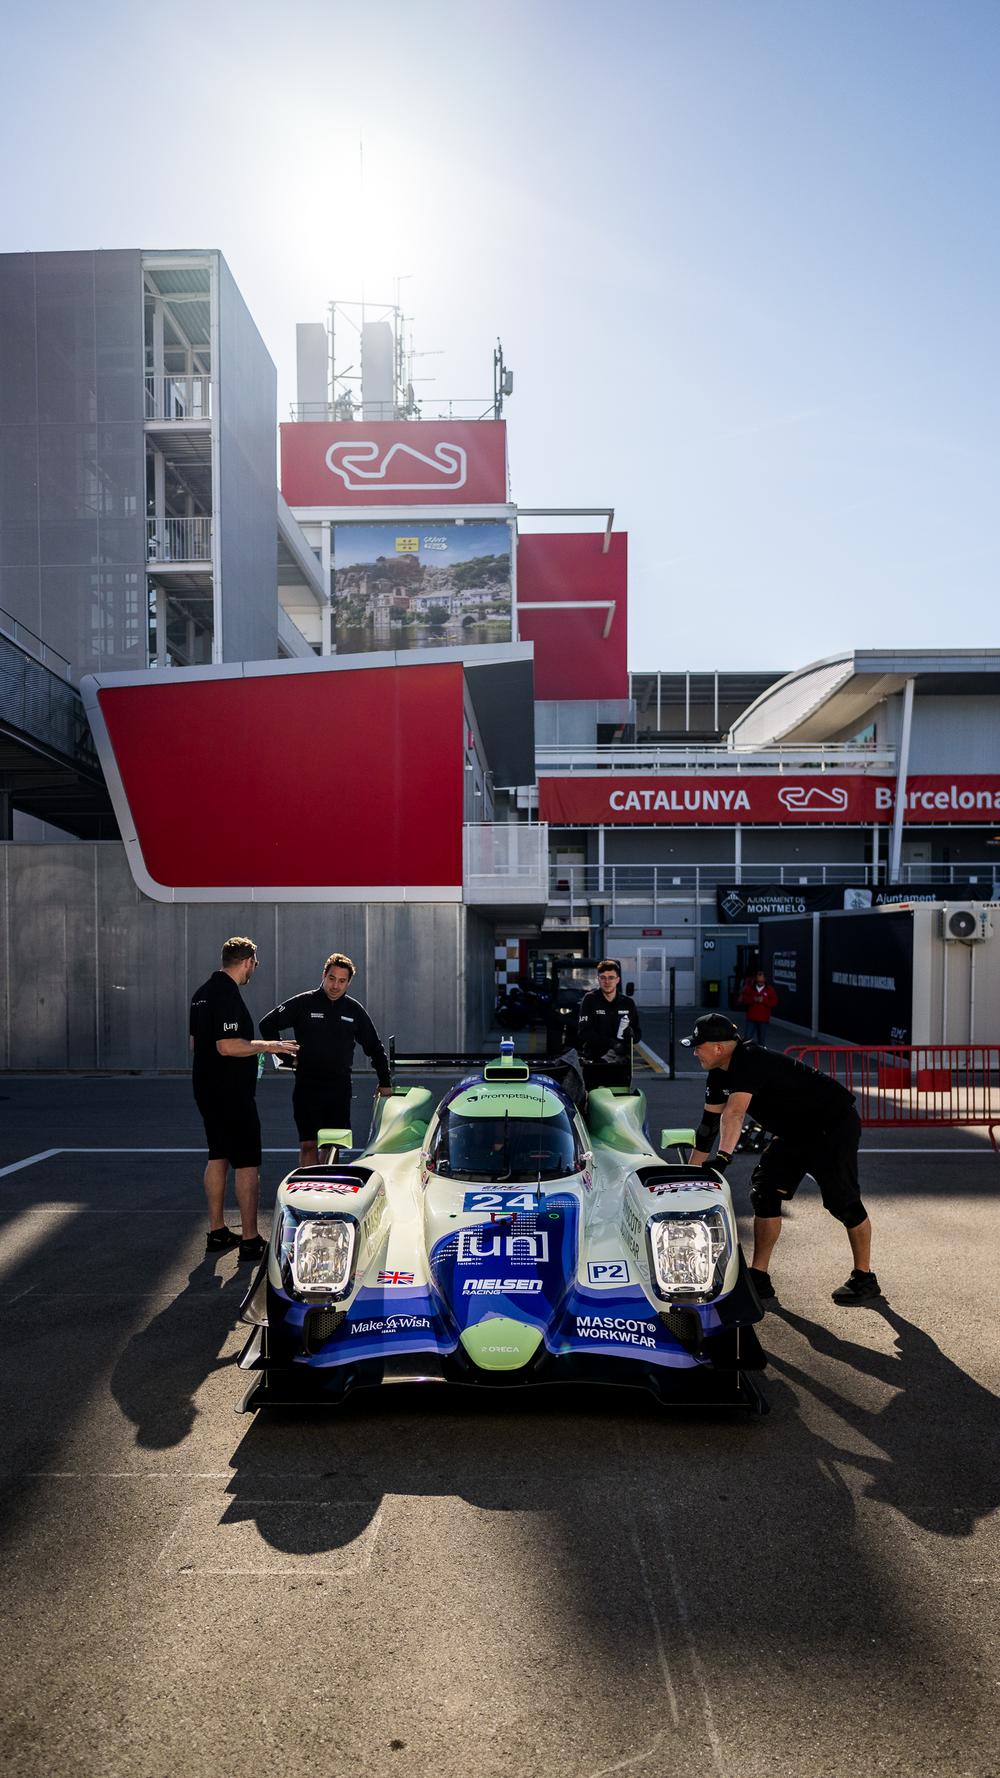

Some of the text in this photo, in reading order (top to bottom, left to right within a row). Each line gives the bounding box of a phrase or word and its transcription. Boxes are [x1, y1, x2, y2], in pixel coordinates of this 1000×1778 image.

[609, 790, 750, 811] CATALUNYA
[876, 893, 937, 904] Ajuntament
[703, 941, 715, 949] 00
[480, 1092, 546, 1103] PromptShop
[470, 1194, 538, 1211] 24
[593, 1265, 624, 1278] P2
[462, 1279, 544, 1290] NIELSEN
[577, 1328, 657, 1349] WORKWEAR
